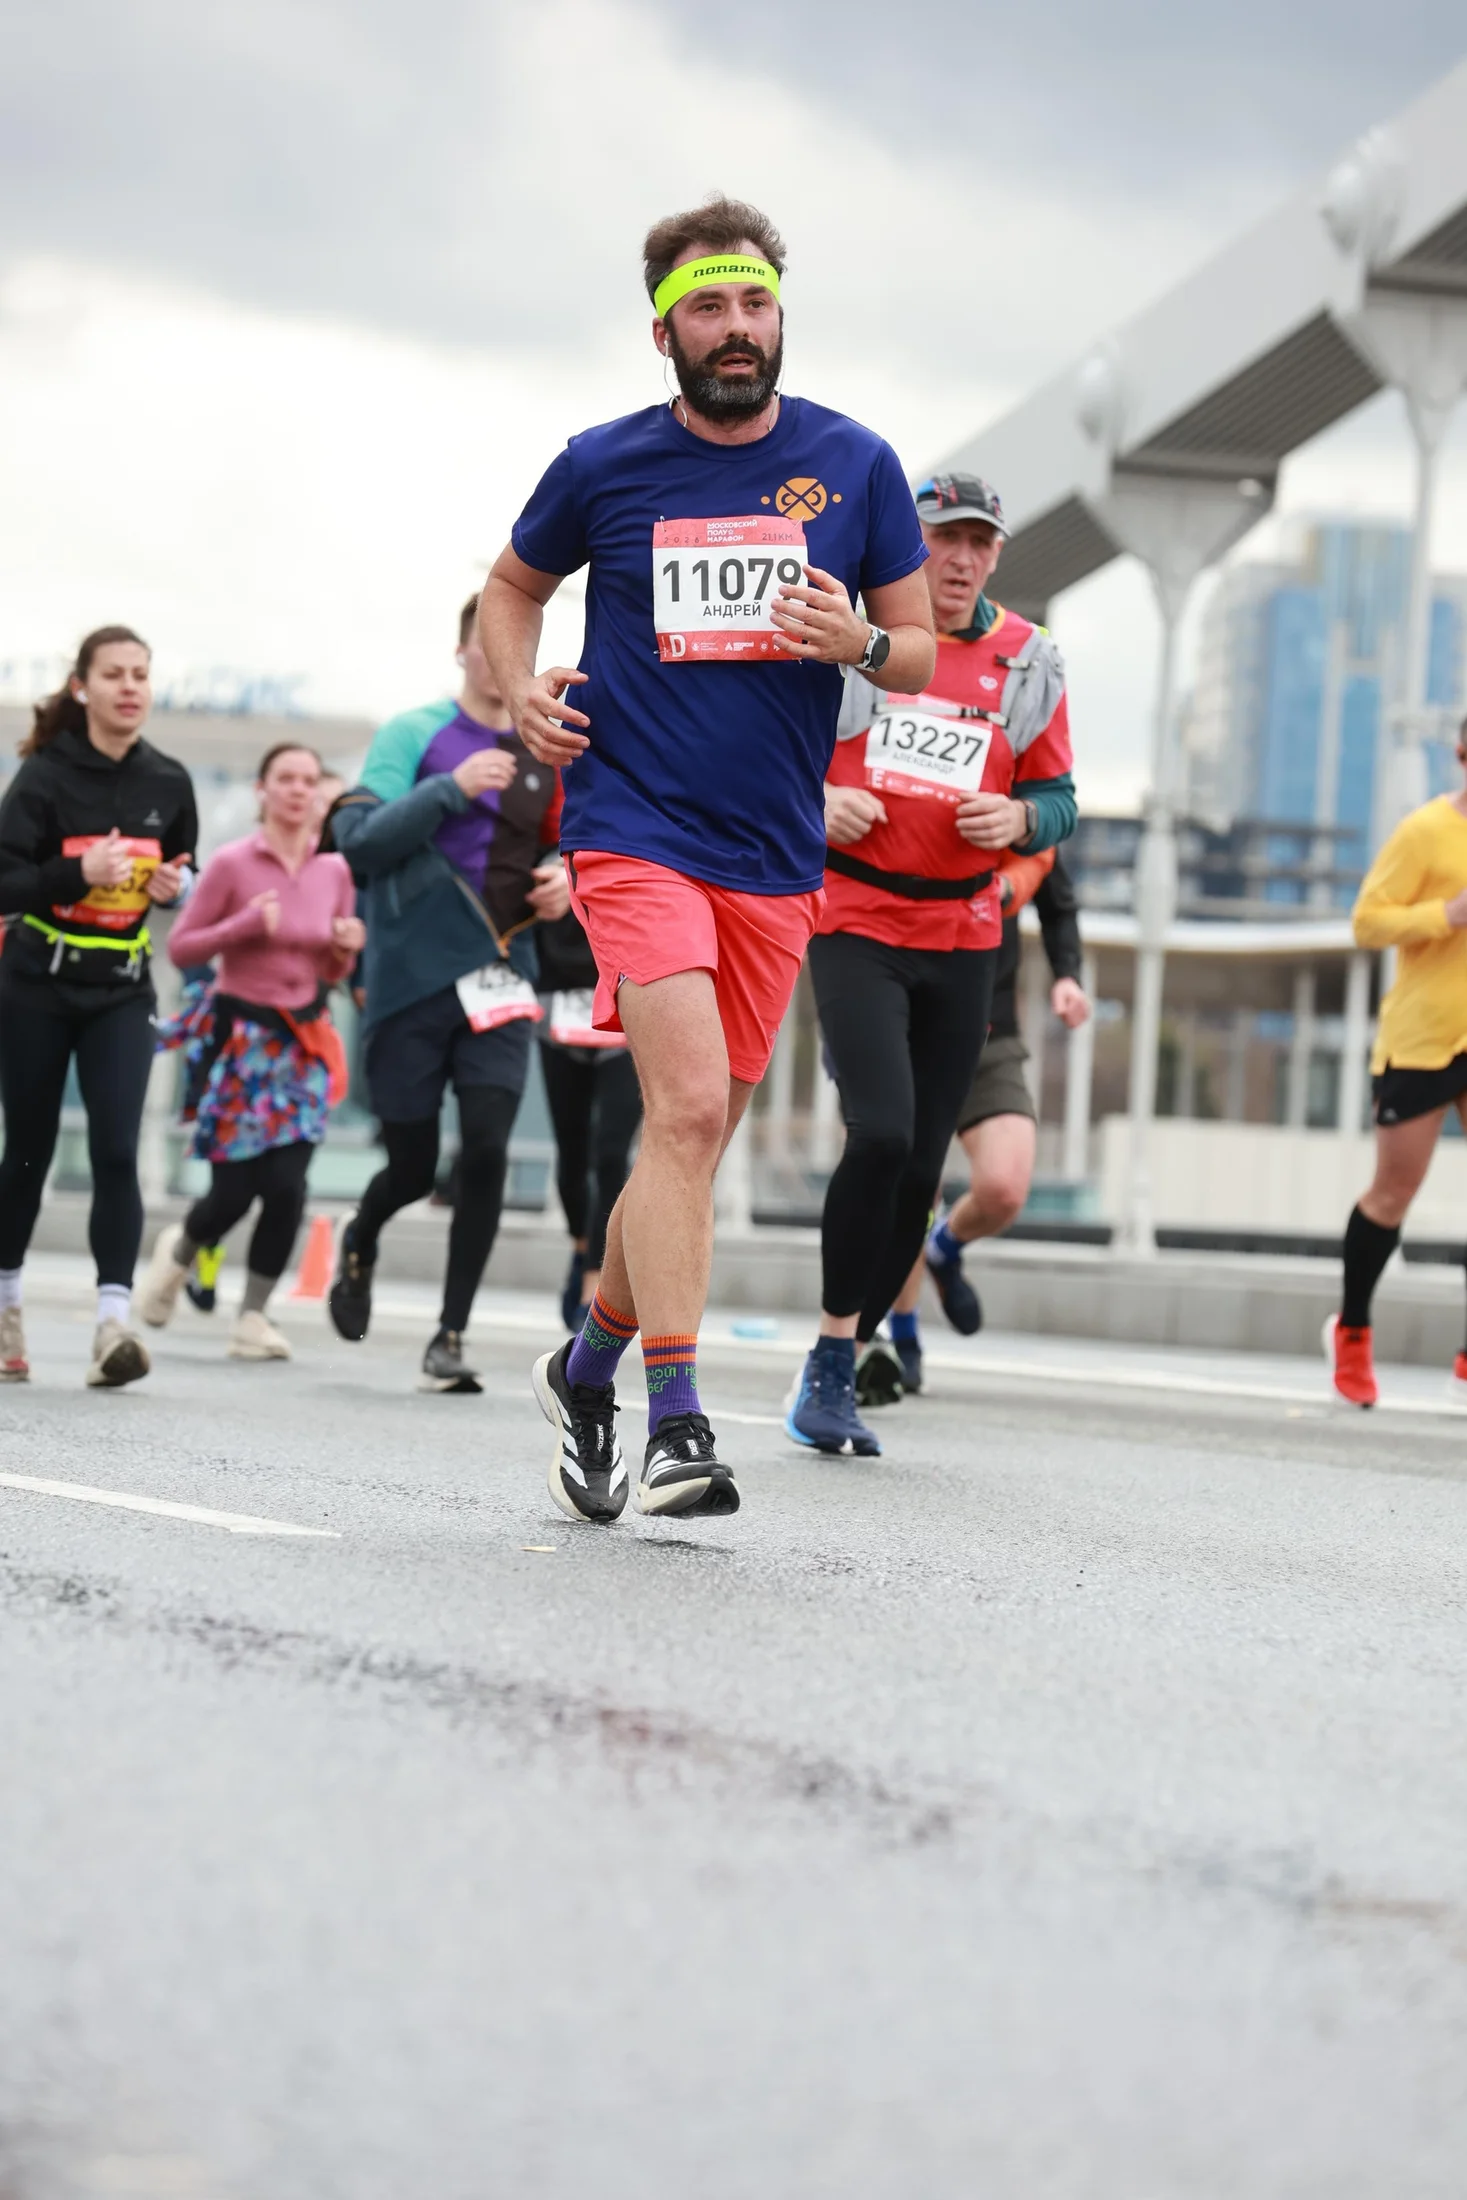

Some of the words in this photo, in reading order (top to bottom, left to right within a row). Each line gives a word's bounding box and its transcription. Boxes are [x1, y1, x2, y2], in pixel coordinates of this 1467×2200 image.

[693, 265, 765, 278] noname
[707, 520, 757, 530] МОСКОВСКИЙ
[707, 535, 744, 543] МАРАФОН
[663, 558, 802, 602] 11079
[702, 601, 761, 618] АНДРЕЙ
[669, 634, 686, 658] D
[879, 716, 984, 766] 13227
[893, 752, 956, 774] АЛЕКСАНДР
